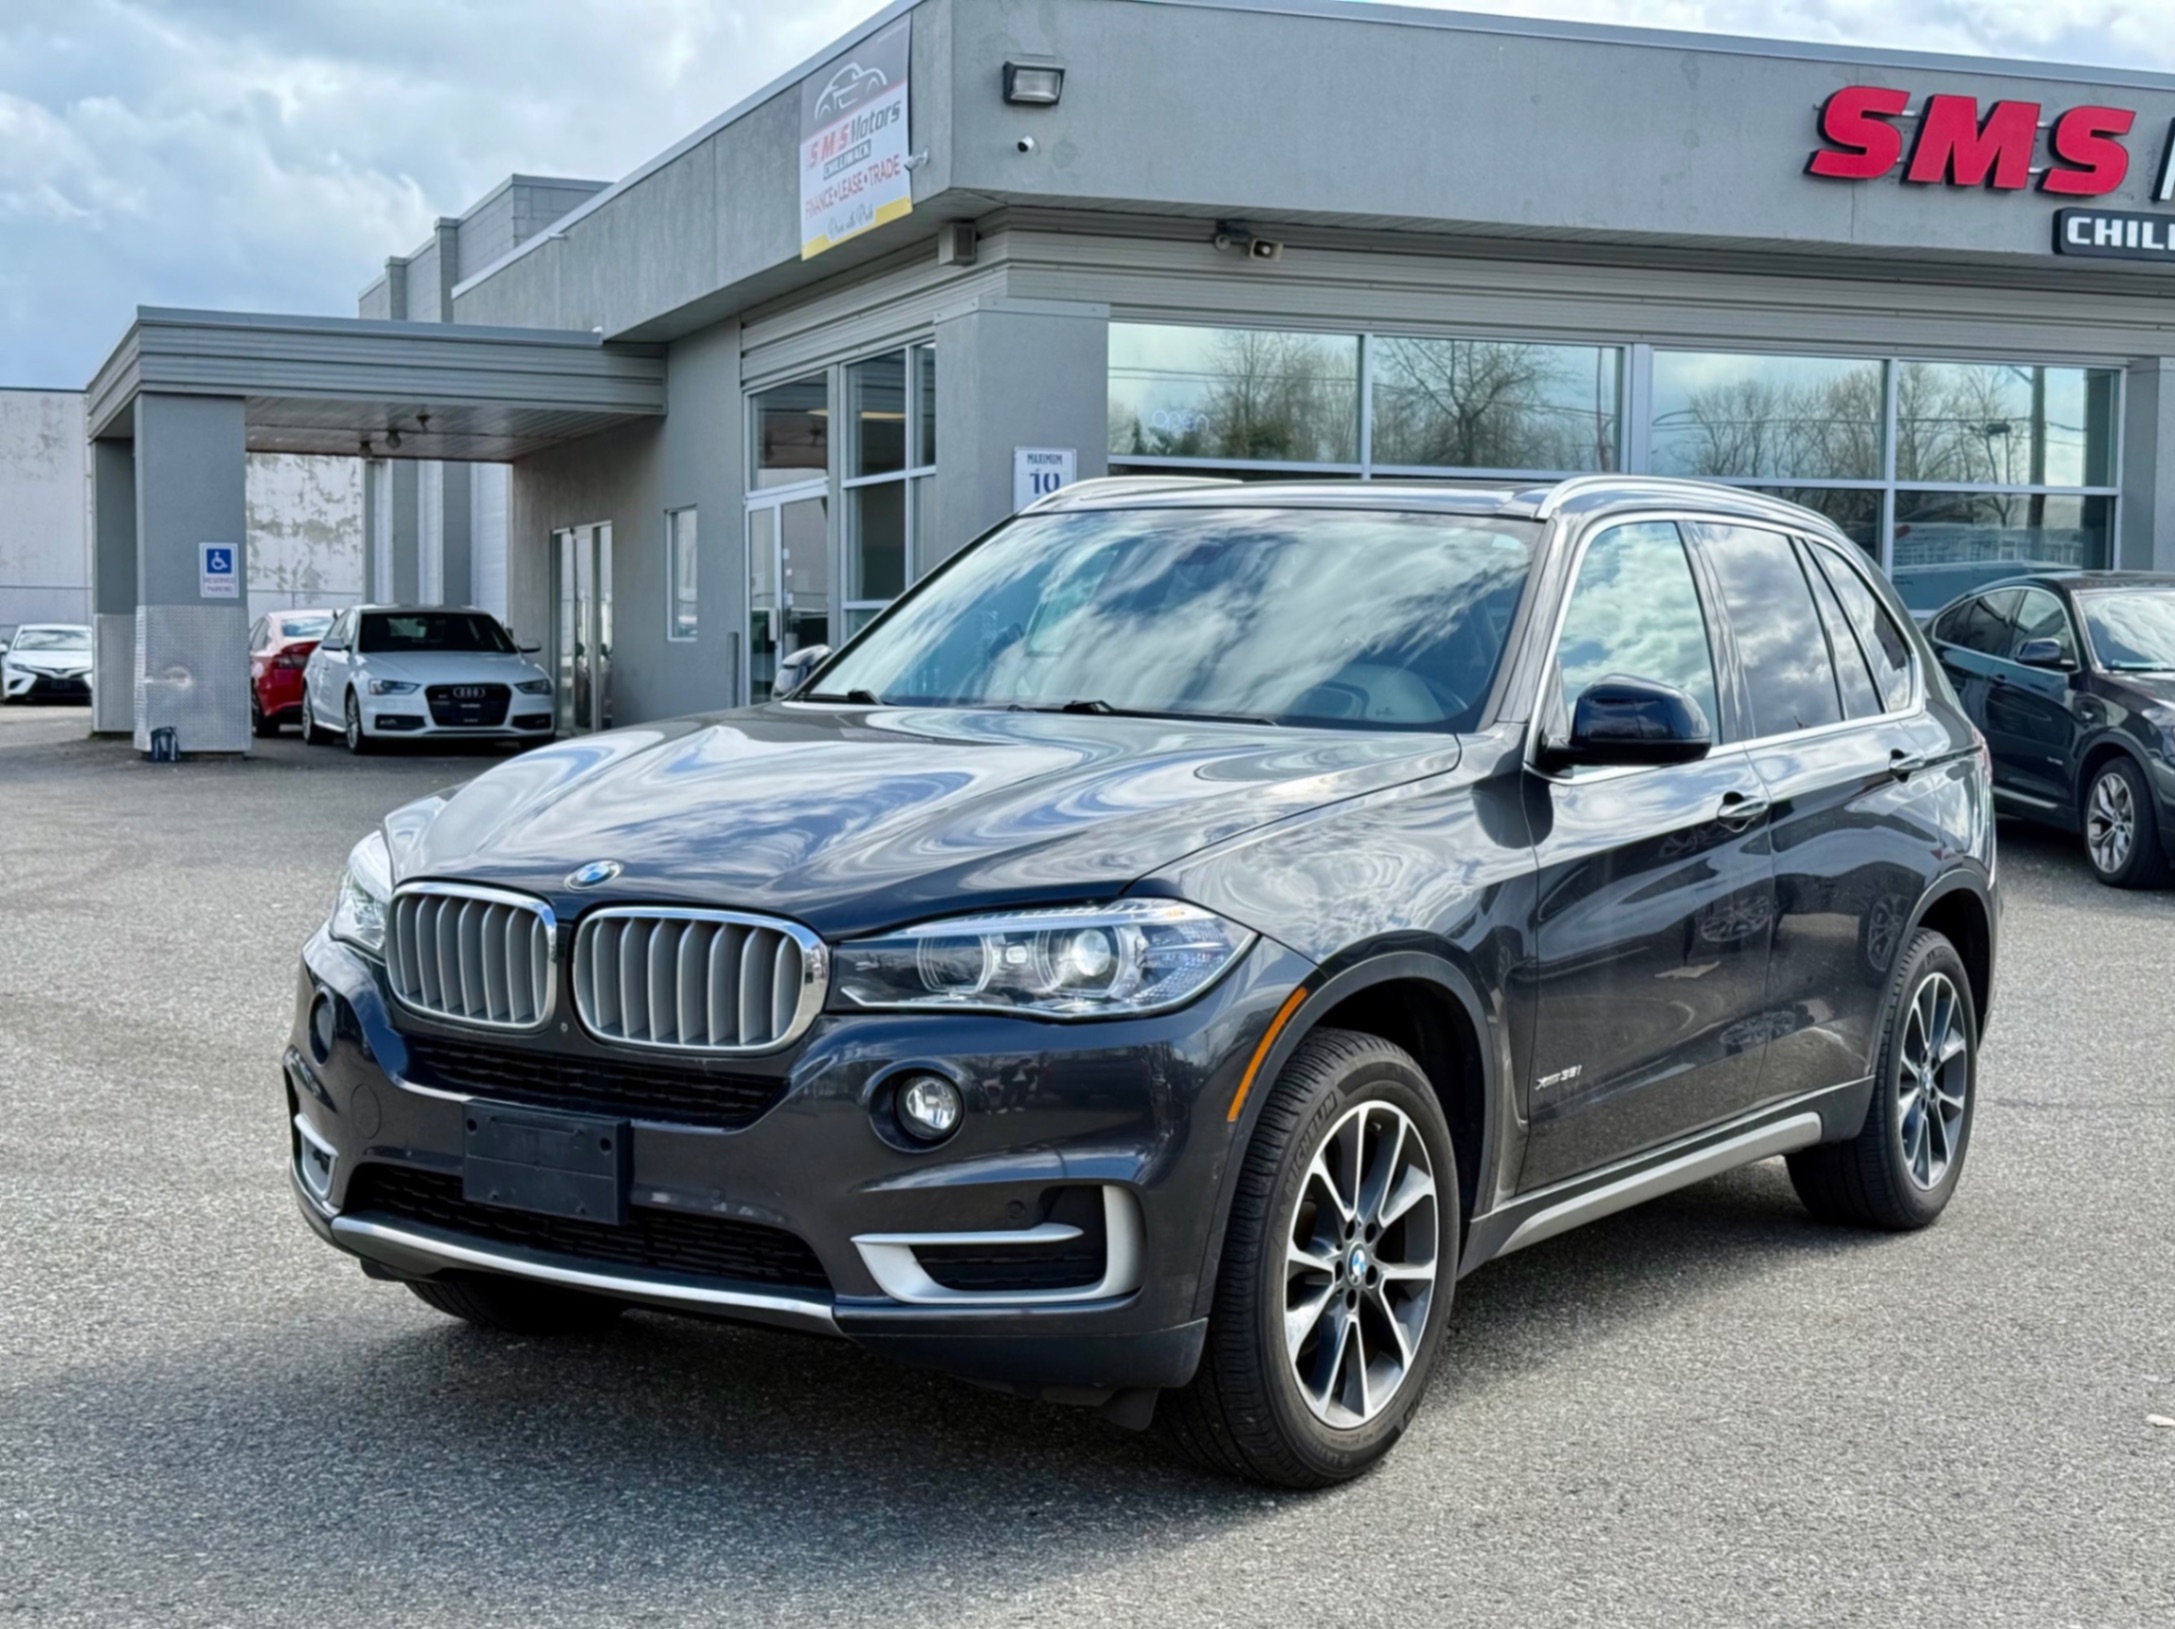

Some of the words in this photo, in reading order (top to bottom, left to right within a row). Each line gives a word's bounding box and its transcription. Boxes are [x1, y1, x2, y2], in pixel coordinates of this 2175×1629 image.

[851, 99, 902, 143] Motors
[1805, 85, 2136, 196] SMS
[1027, 453, 1063, 465] MAXIMUM
[1029, 472, 1061, 495] 10
